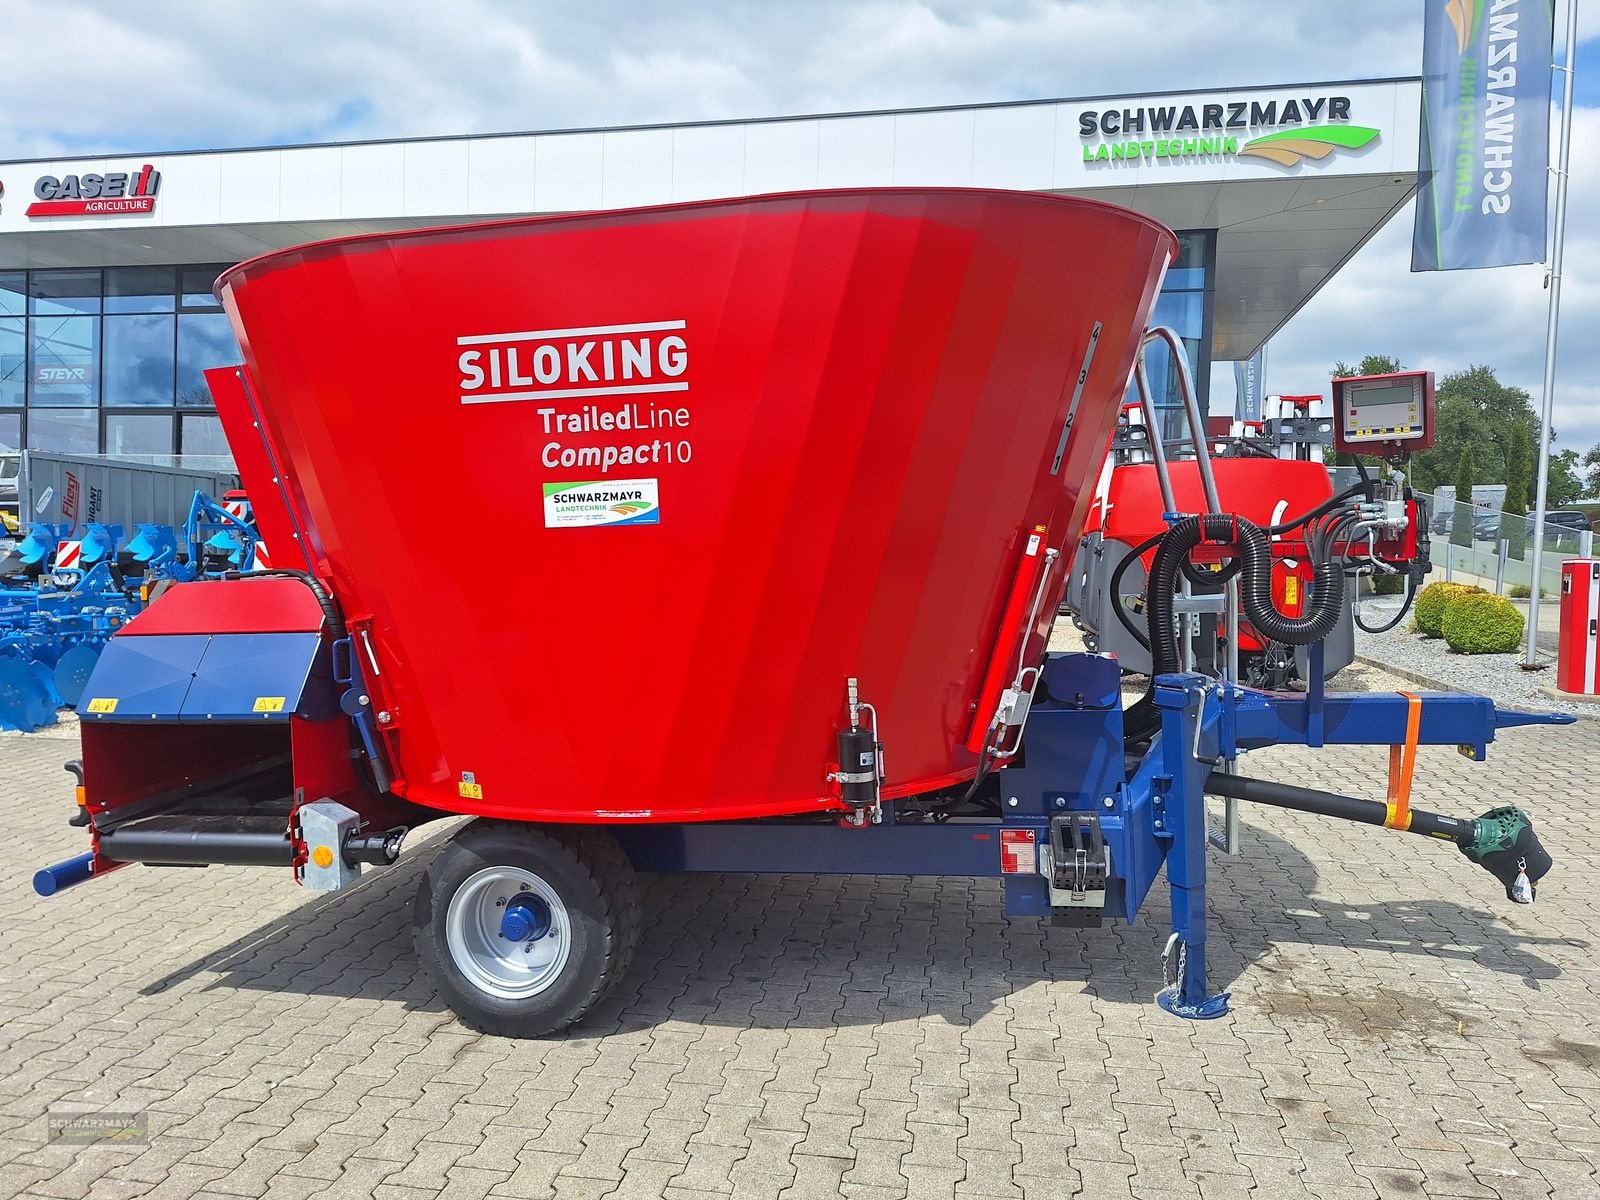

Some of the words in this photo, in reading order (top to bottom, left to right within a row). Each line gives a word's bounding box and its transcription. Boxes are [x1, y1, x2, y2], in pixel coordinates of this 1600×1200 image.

[1078, 96, 1351, 136] SCHWARZMAYR
[1083, 136, 1238, 162] LANDTECHNIK
[34, 172, 128, 200] CASE
[85, 200, 148, 211] AGRICULTURE
[1092, 326, 1100, 342] 4
[458, 335, 688, 390] SILOKING
[38, 368, 85, 380] STEYR
[1078, 369, 1087, 385] 3
[537, 402, 690, 434] TrailedLine
[1065, 412, 1074, 428] 2
[541, 440, 692, 473] Compact10
[1054, 455, 1061, 470] 1
[62, 471, 80, 518] Fliegl
[553, 490, 642, 504] SCHWARZMAYR
[556, 504, 607, 513] LANDTECHNIK
